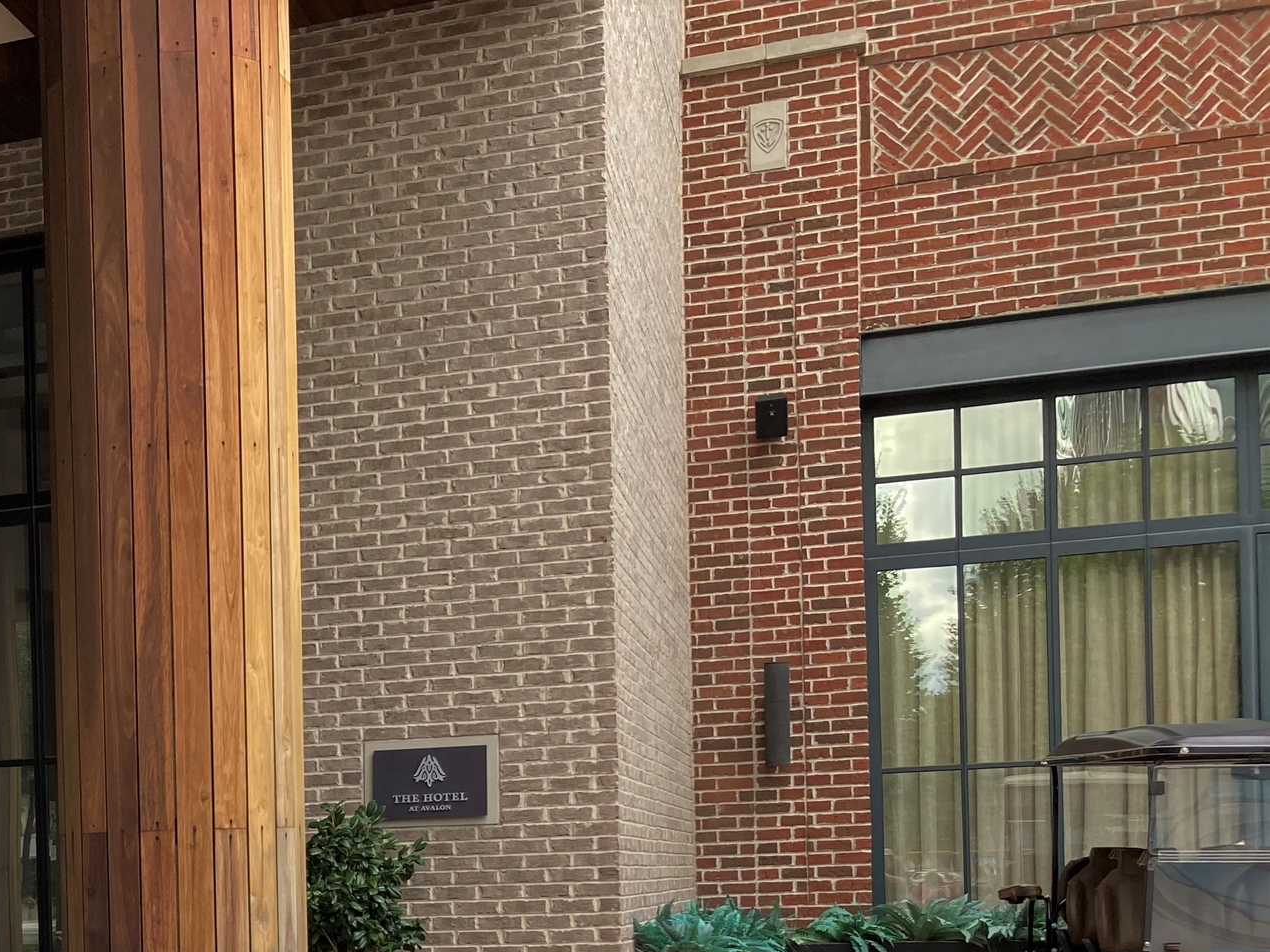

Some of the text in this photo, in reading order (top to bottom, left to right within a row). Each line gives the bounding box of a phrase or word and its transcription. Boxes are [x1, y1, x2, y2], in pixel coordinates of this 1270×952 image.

[392, 791, 469, 804] THE HOTEL
[420, 804, 452, 812] AVALON
